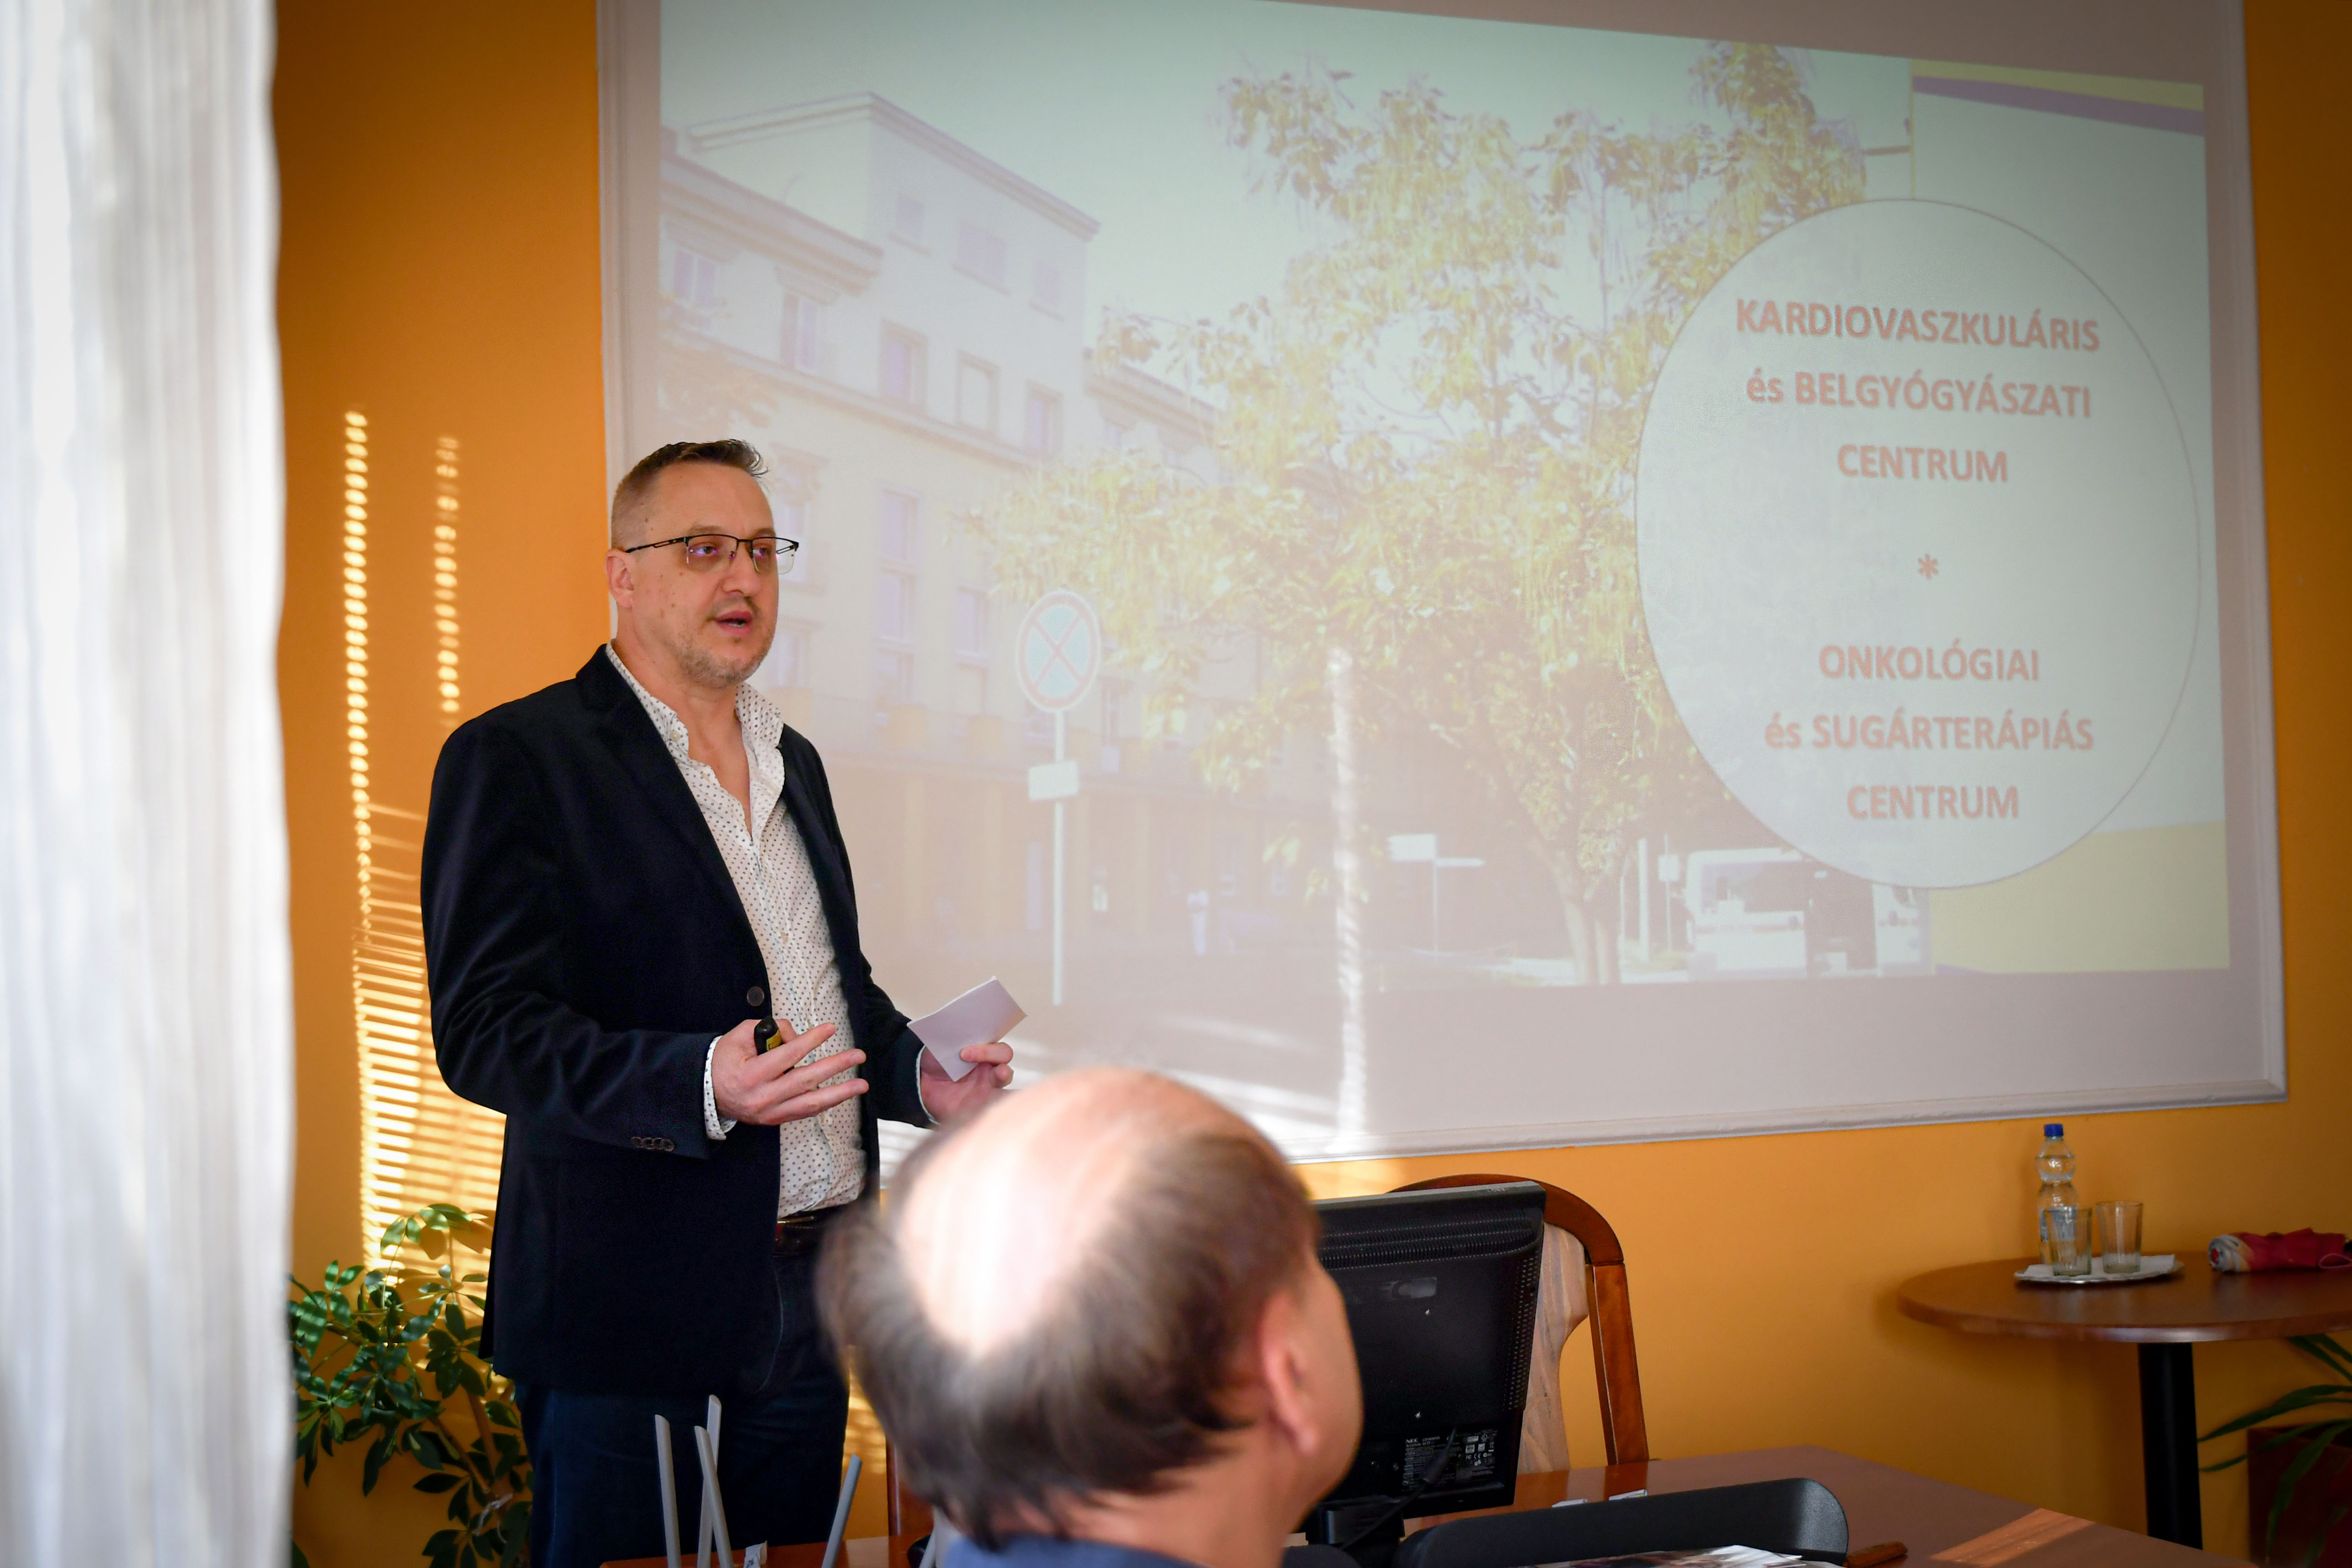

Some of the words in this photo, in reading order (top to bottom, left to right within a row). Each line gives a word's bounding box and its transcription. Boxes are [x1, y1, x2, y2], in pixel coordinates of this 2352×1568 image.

[1736, 299, 2100, 351] KARDIOVASZKULÁRIS
[1746, 368, 1783, 403] és
[1795, 369, 2091, 417] BELGYÓGYÁSZATI
[1837, 444, 2008, 482] CENTRUM
[1819, 640, 2038, 681] ONKOLÓGIAI
[1765, 712, 1801, 748] és
[1813, 708, 2093, 750] SUGÁRTERÁPIÁS
[1847, 784, 2018, 819] CENTRUM
